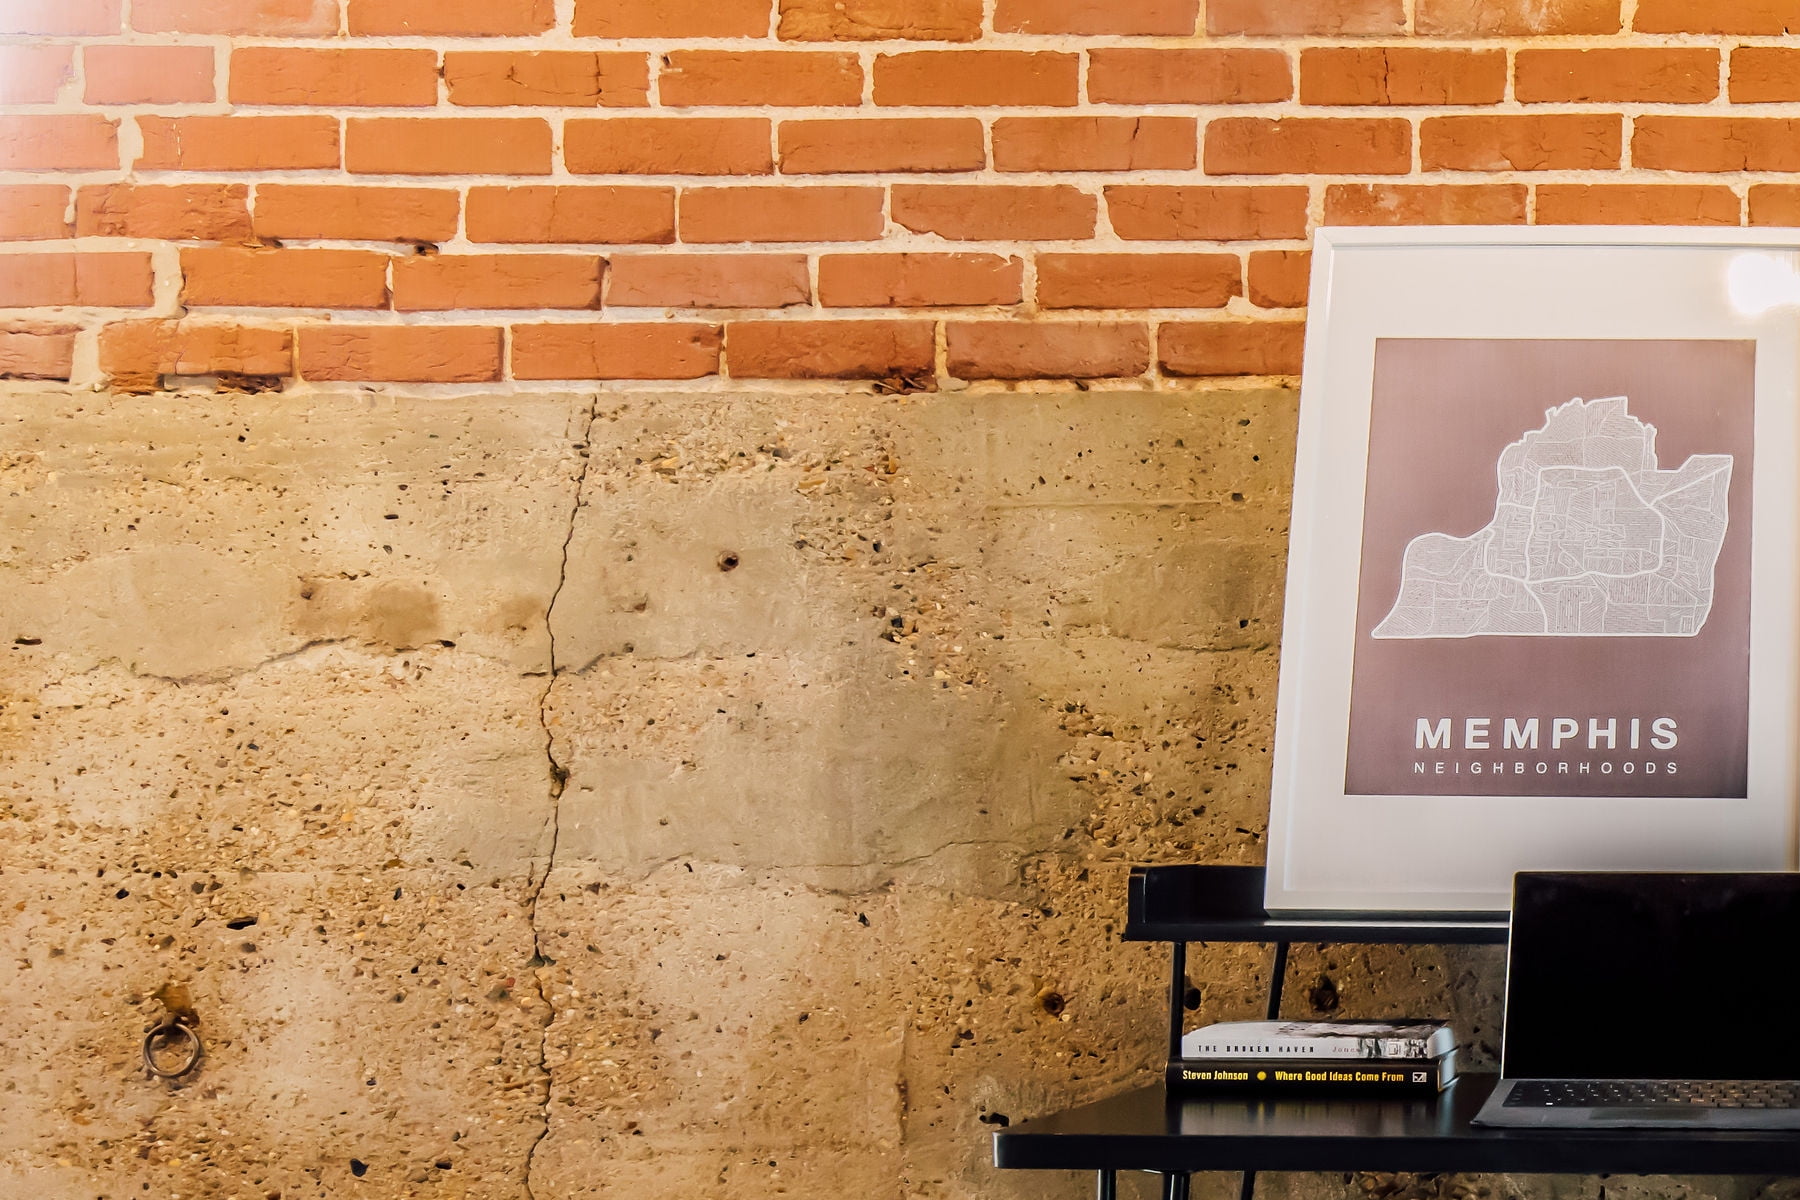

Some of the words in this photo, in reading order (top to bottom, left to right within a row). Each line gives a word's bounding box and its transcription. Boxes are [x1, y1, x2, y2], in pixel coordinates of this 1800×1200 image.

[1415, 717, 1678, 750] MEMPHIS
[1414, 762, 1677, 774] NEIGHBORHOODS
[1182, 1069, 1212, 1080] Steven
[1213, 1070, 1249, 1081] Johnson
[1275, 1070, 1303, 1081] Where
[1305, 1071, 1327, 1081] Good
[1329, 1071, 1353, 1081] Ideas
[1355, 1071, 1379, 1082] Come
[1381, 1072, 1404, 1082] From
